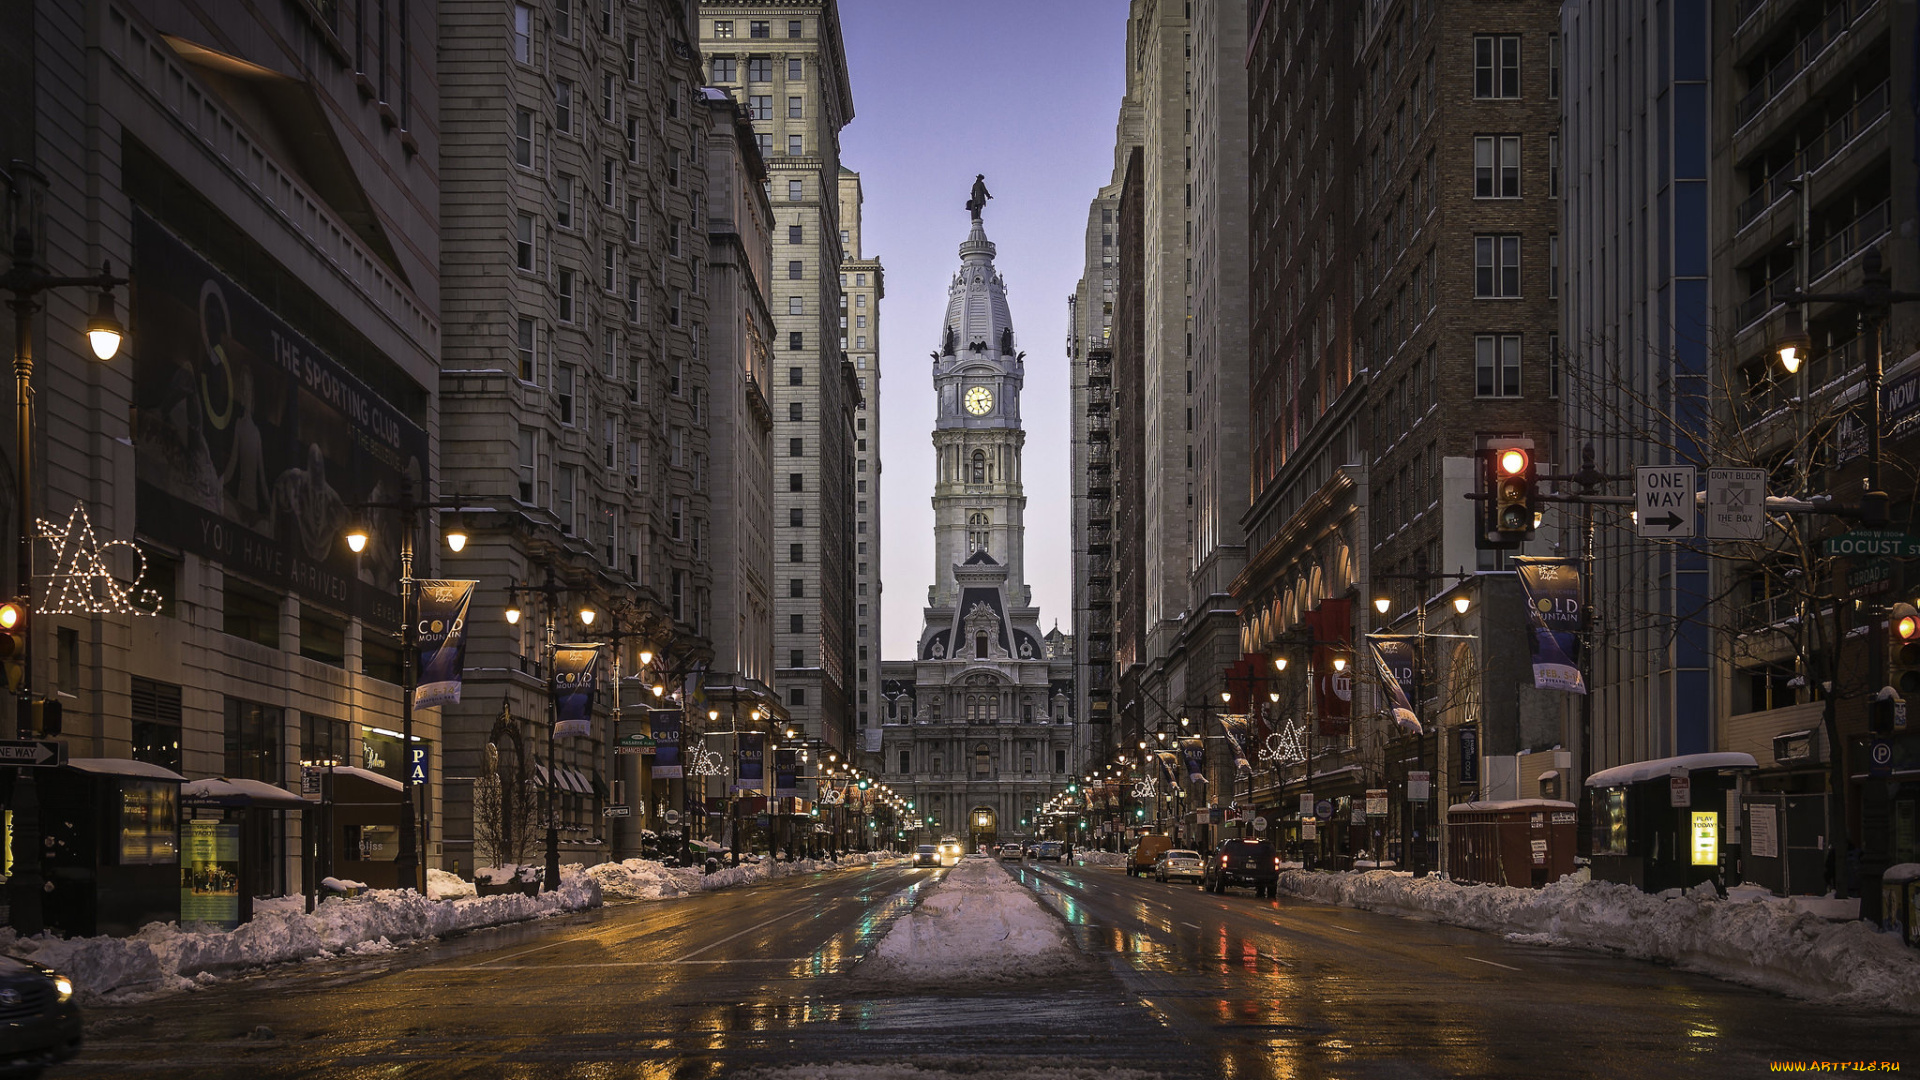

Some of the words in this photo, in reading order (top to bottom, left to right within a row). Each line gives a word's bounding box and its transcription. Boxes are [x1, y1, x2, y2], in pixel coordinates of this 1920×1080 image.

[271, 330, 301, 378] THE
[305, 356, 369, 426] SPORTING
[372, 408, 400, 449] CLUB
[1889, 378, 1917, 413] NOW
[1648, 473, 1684, 488] ONE
[1736, 472, 1761, 481] BLOCK
[1646, 492, 1685, 507] WAY
[1718, 514, 1732, 523] THE
[1737, 514, 1752, 523] BOX
[1831, 540, 1902, 554] LOCUST
[201, 519, 233, 555] YOU
[244, 539, 283, 577] HAVE
[290, 559, 347, 602] ARRIVED
[1855, 566, 1880, 586] BROAD
[1528, 598, 1578, 614] COLD
[653, 730, 680, 741] COLD
[15, 748, 36, 758] WAY
[740, 750, 762, 758] COLD
[1878, 748, 1887, 761] P
[358, 840, 383, 851] bliss
